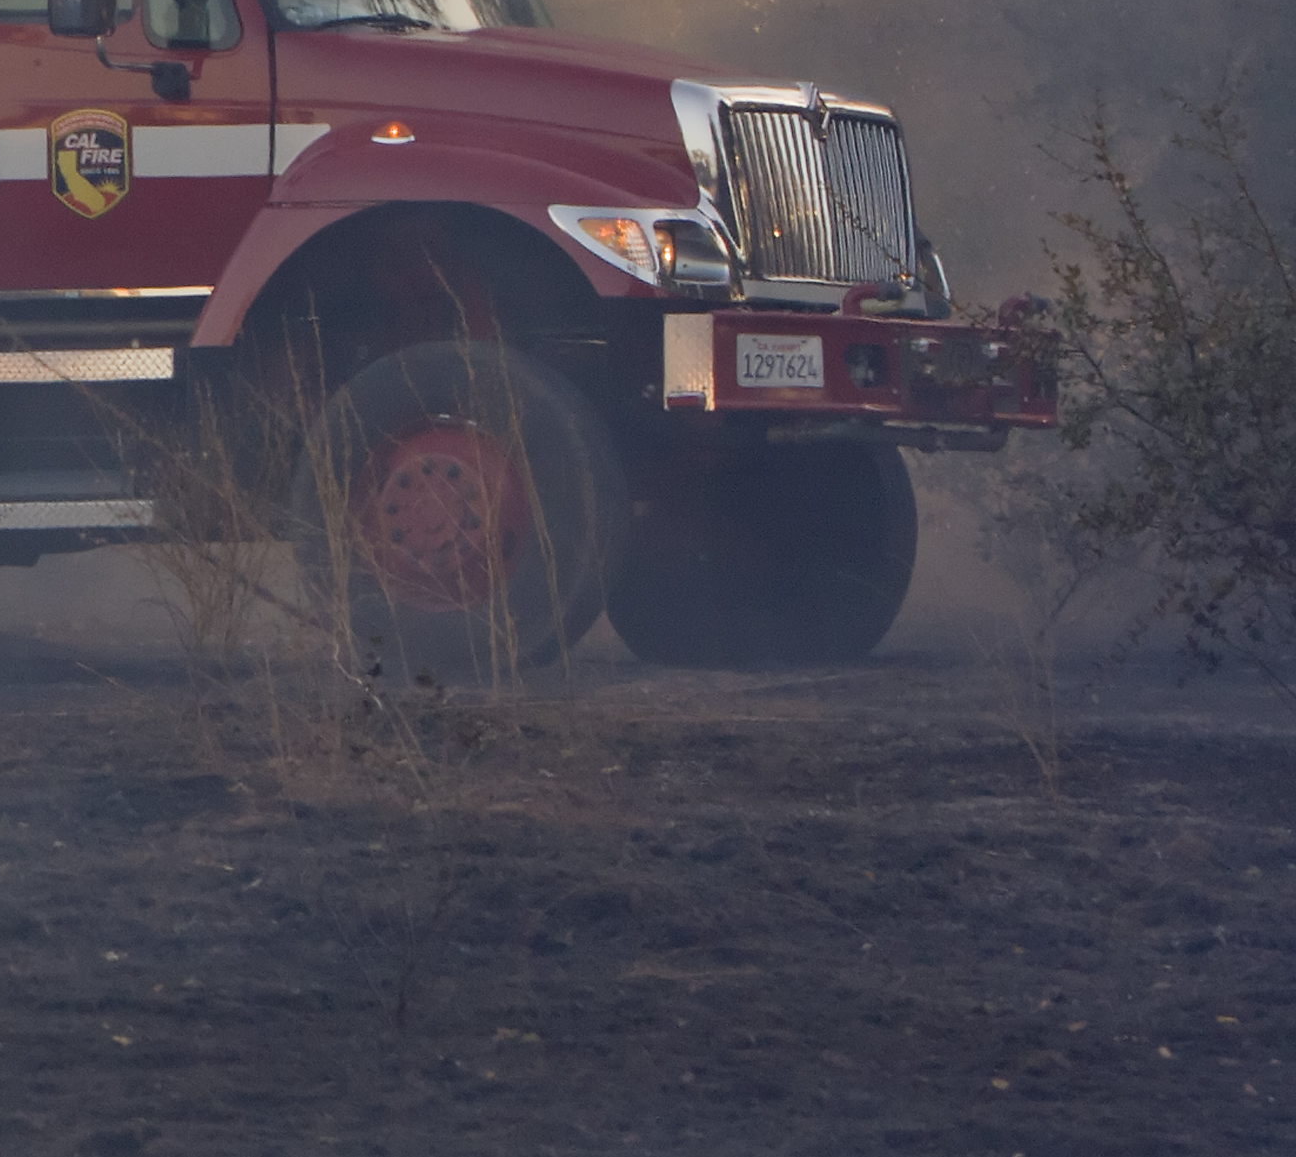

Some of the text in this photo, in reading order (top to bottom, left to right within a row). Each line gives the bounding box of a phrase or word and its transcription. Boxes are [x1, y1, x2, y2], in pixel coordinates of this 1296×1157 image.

[65, 133, 100, 149] CAL
[80, 149, 123, 164] FIRE
[744, 354, 817, 378] 1297624
